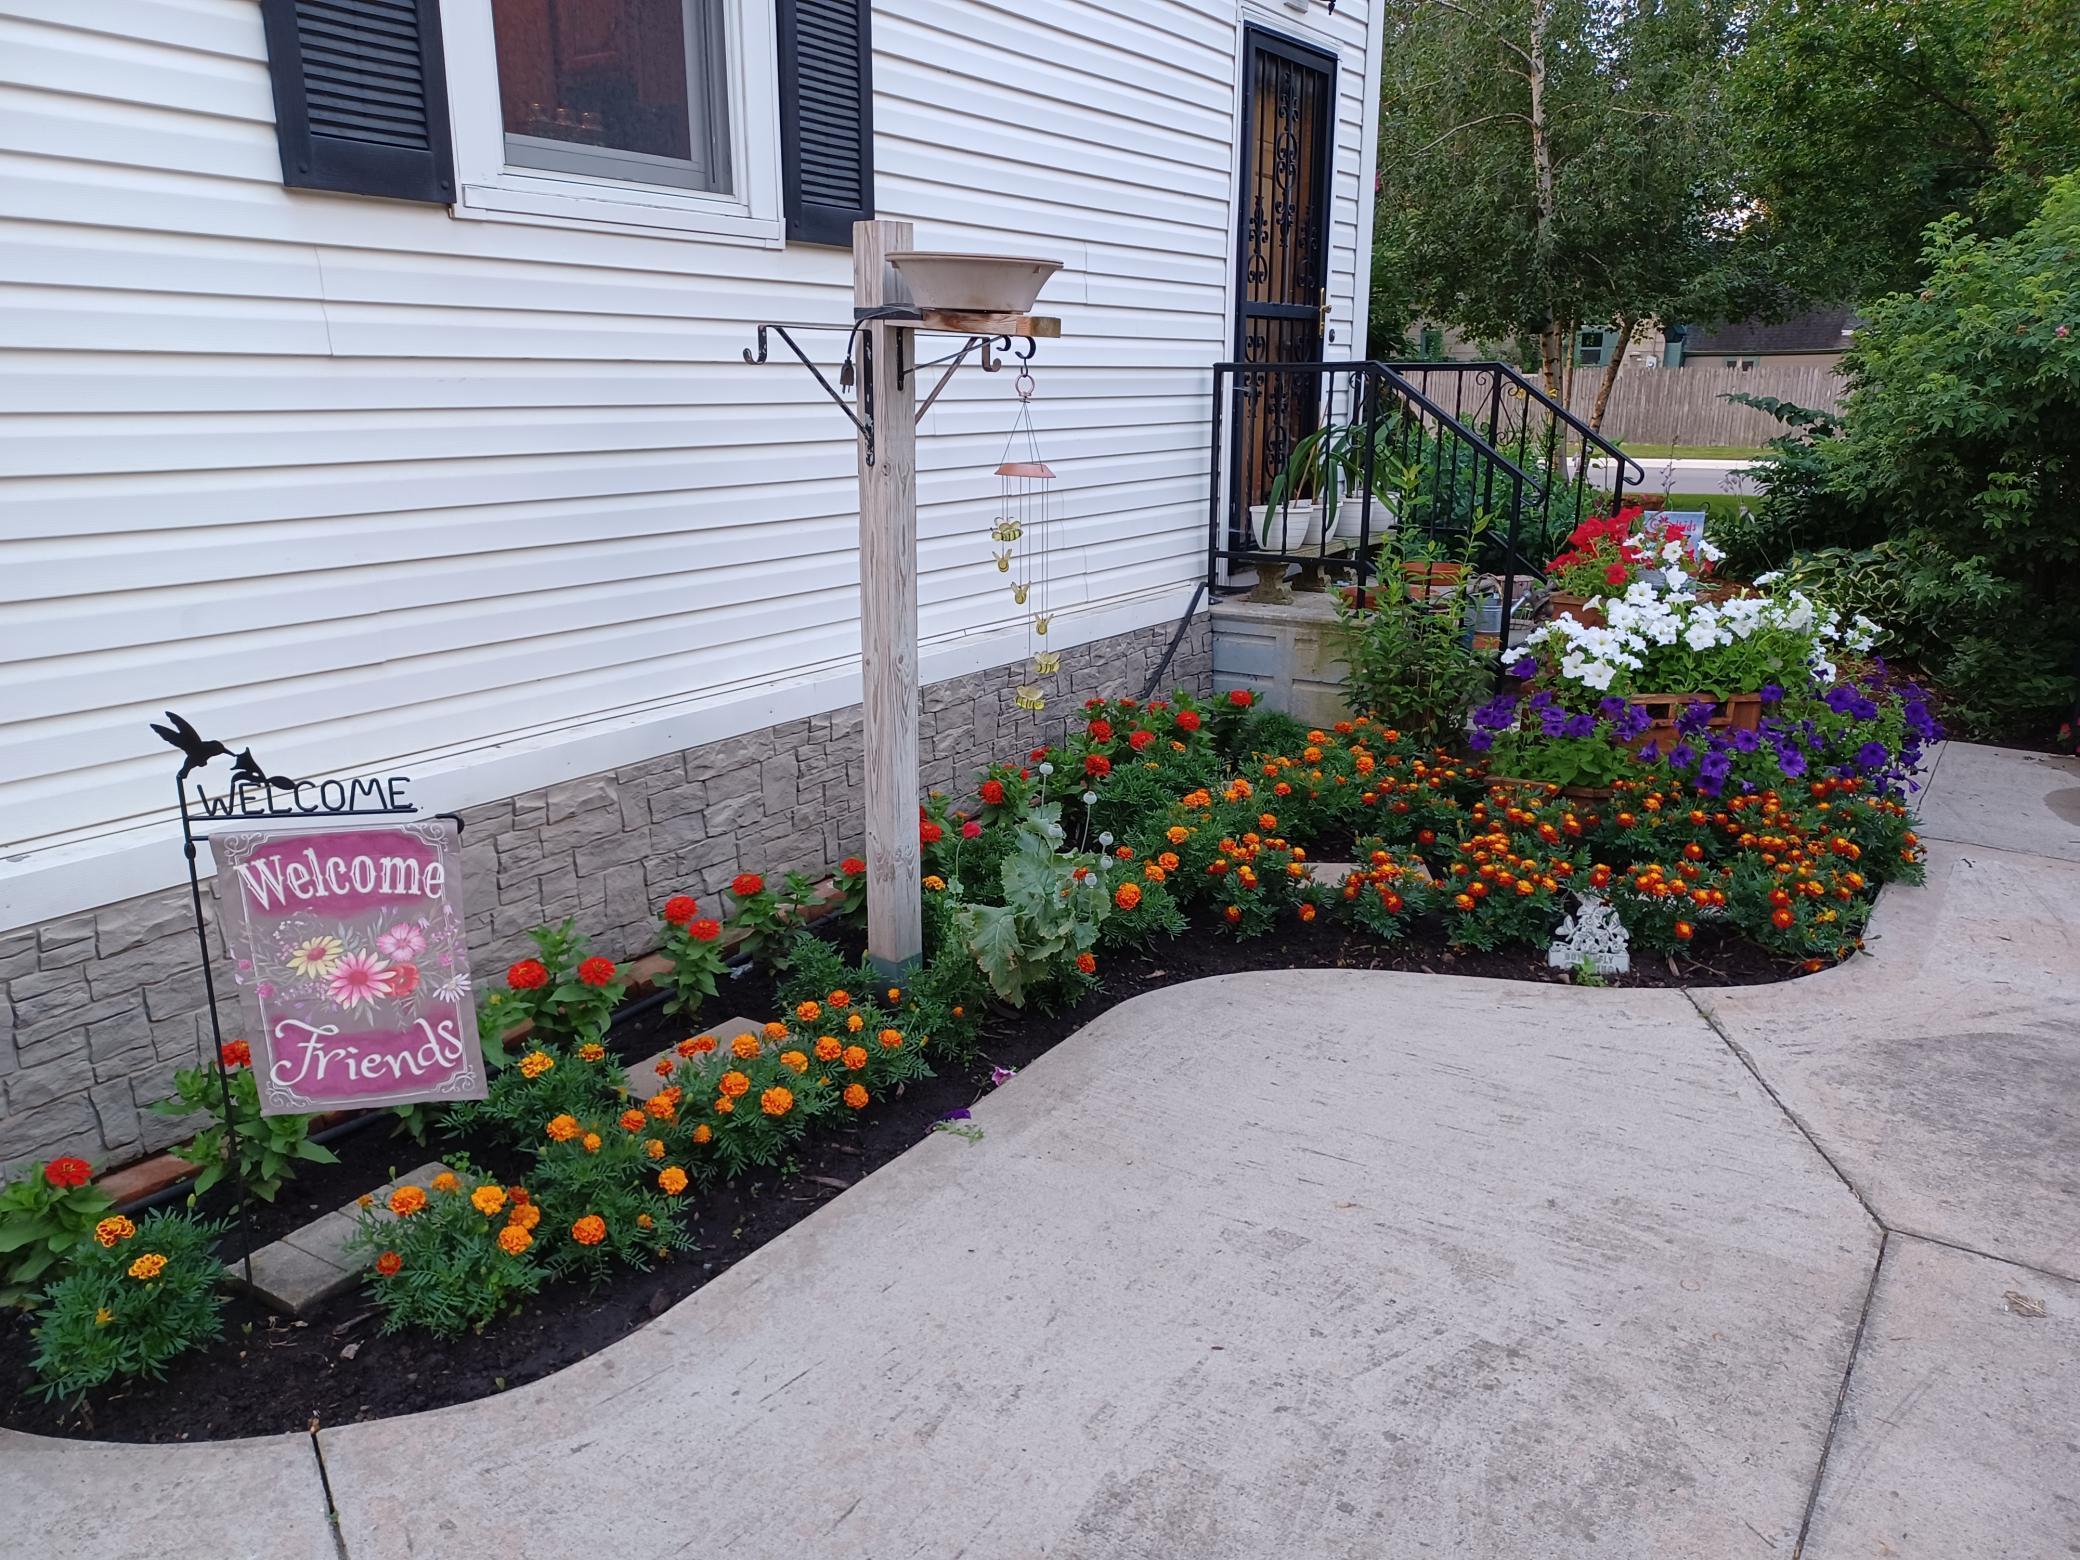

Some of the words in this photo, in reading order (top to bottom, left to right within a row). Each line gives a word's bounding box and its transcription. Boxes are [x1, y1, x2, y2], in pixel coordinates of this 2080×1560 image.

[196, 776, 414, 816] WELCOME
[234, 848, 445, 911] Welcome
[270, 1018, 463, 1086] Friends
